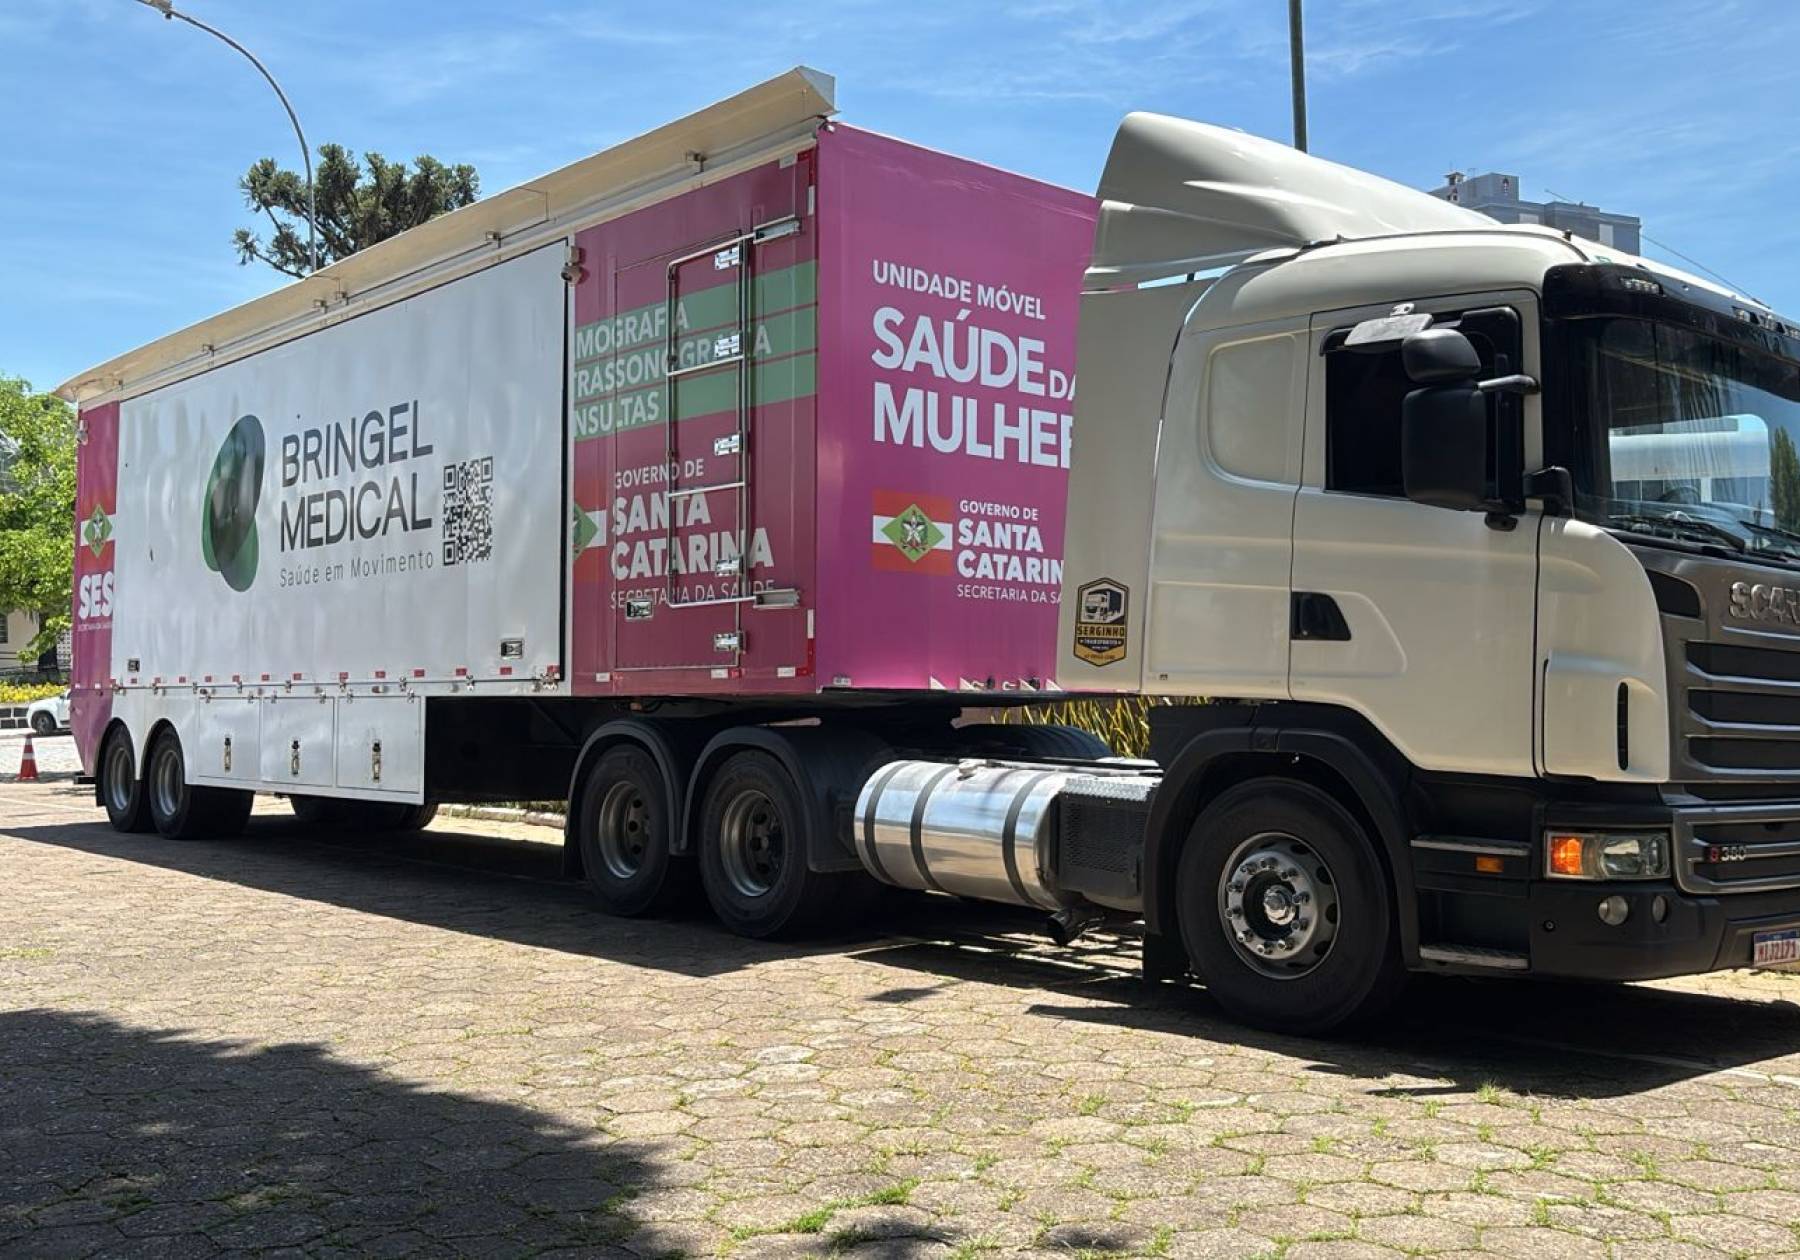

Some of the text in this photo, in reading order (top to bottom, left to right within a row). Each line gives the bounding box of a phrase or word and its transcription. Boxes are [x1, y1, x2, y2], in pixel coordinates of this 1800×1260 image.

[873, 259, 1046, 320] UNIDADE MÓVEL
[576, 300, 690, 359] MOGRAFA
[872, 307, 1046, 397] SAÚDE
[281, 400, 434, 488] BRINGEL
[614, 458, 705, 489] GOVERNO DE
[280, 472, 433, 553] MEDICAL
[611, 491, 712, 536] SANTA
[959, 500, 1039, 522] GOVERNO DE
[611, 527, 775, 580] CATARINA
[958, 517, 1044, 553] SANTA
[280, 551, 434, 588] Saúde em Movimento
[695, 584, 717, 602] DA
[720, 579, 775, 600] SADE
[78, 571, 114, 619] SES
[956, 584, 1028, 603] SECRETARIA
[1031, 590, 1048, 604] DA
[1076, 626, 1125, 637] SERGINHO
